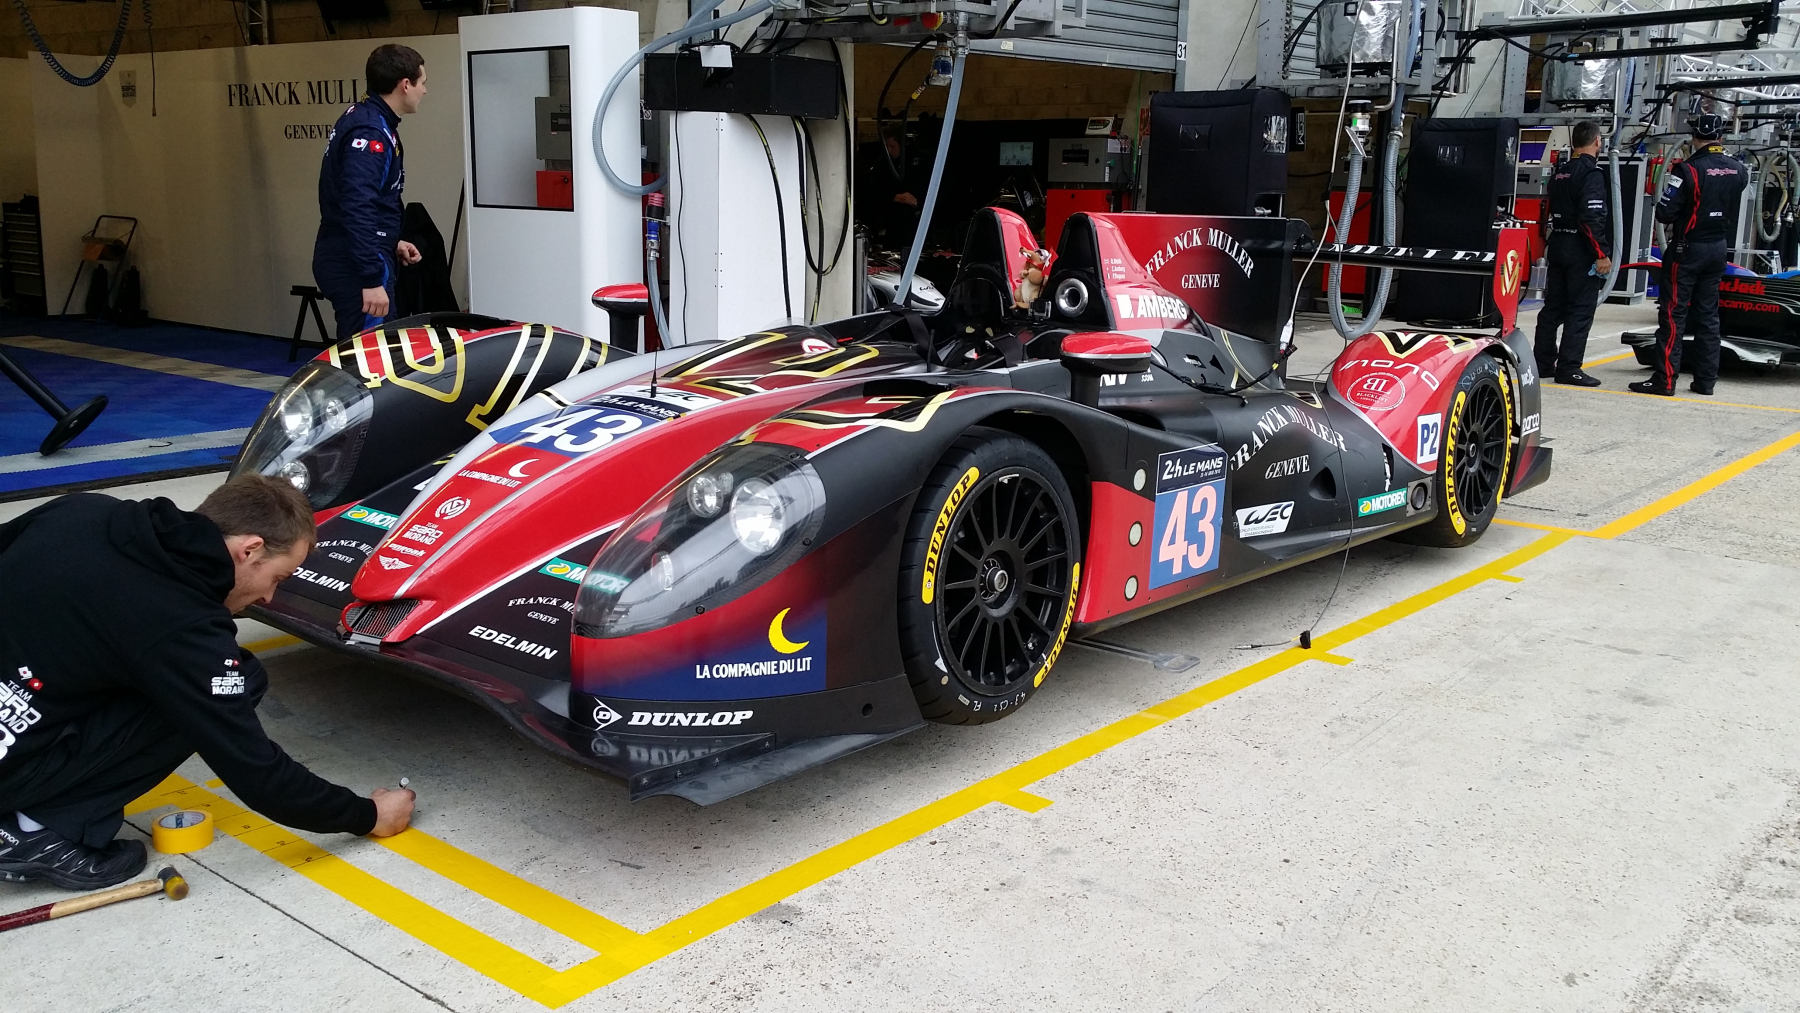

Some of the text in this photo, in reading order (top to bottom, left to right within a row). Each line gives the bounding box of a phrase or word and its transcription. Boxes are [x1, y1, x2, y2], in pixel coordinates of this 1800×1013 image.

[1178, 44, 1187, 58] 31
[228, 79, 367, 107] FRANCK MULL
[1145, 227, 1255, 279] FRANCK MULLER
[1181, 273, 1221, 289] GENEVE
[1137, 294, 1188, 321] AMBERG
[519, 407, 643, 453] 43
[1281, 404, 1348, 453] MULLER
[1420, 421, 1439, 457] P2
[1183, 462, 1196, 476] LE
[1196, 456, 1224, 474] MANS
[1265, 454, 1311, 480] GENEVE
[458, 469, 470, 477] LA
[466, 470, 504, 486] COMPAGNIE
[1372, 489, 1407, 512] MOTOREX
[362, 511, 399, 528] MOT
[926, 473, 971, 577] DUNLOP
[1243, 503, 1294, 526] WEC
[402, 530, 436, 546] MORAND
[1158, 485, 1217, 575] 43
[315, 539, 361, 548] FRANCK
[328, 551, 355, 564] GENEVE
[507, 596, 561, 607] FRANCK
[527, 610, 560, 625] GENEVE
[468, 625, 559, 660] EDELMIN
[695, 656, 812, 679] LA COMPAGNIE DU LIT
[7, 680, 33, 702] TEAM
[212, 685, 245, 695] MORAND
[0, 703, 28, 734] AND
[627, 710, 753, 726] DUNLOP
[0, 828, 20, 846] omon
